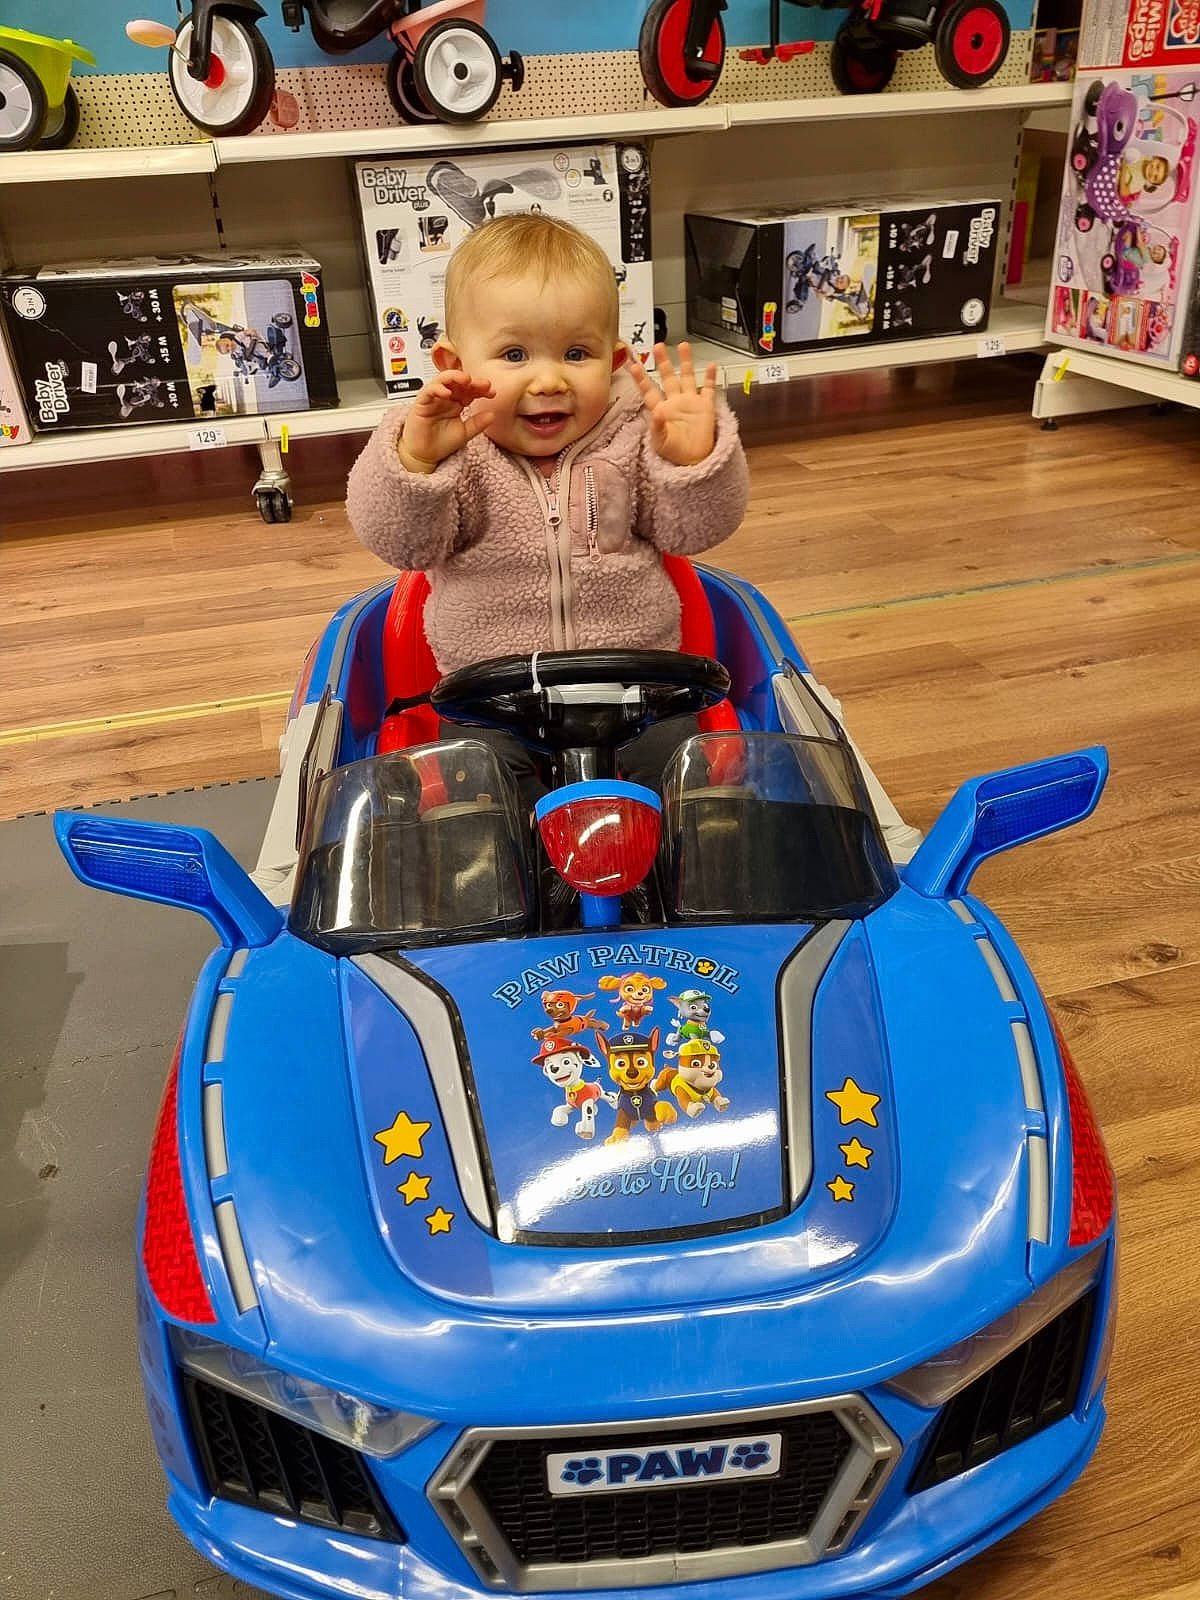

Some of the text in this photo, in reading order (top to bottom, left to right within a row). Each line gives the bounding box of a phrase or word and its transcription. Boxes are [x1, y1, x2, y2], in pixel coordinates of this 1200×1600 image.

[362, 168, 406, 187] Baby
[374, 185, 426, 205] Driver
[967, 218, 984, 264] Driver
[979, 208, 995, 248] Baby
[149, 289, 160, 299] M
[158, 336, 169, 346] M
[35, 380, 58, 422] Baby
[45, 361, 69, 413] Driver
[492, 943, 742, 1009] PAW PATROL
[573, 1152, 741, 1208] ere to Help!
[606, 1444, 730, 1486] PAW
